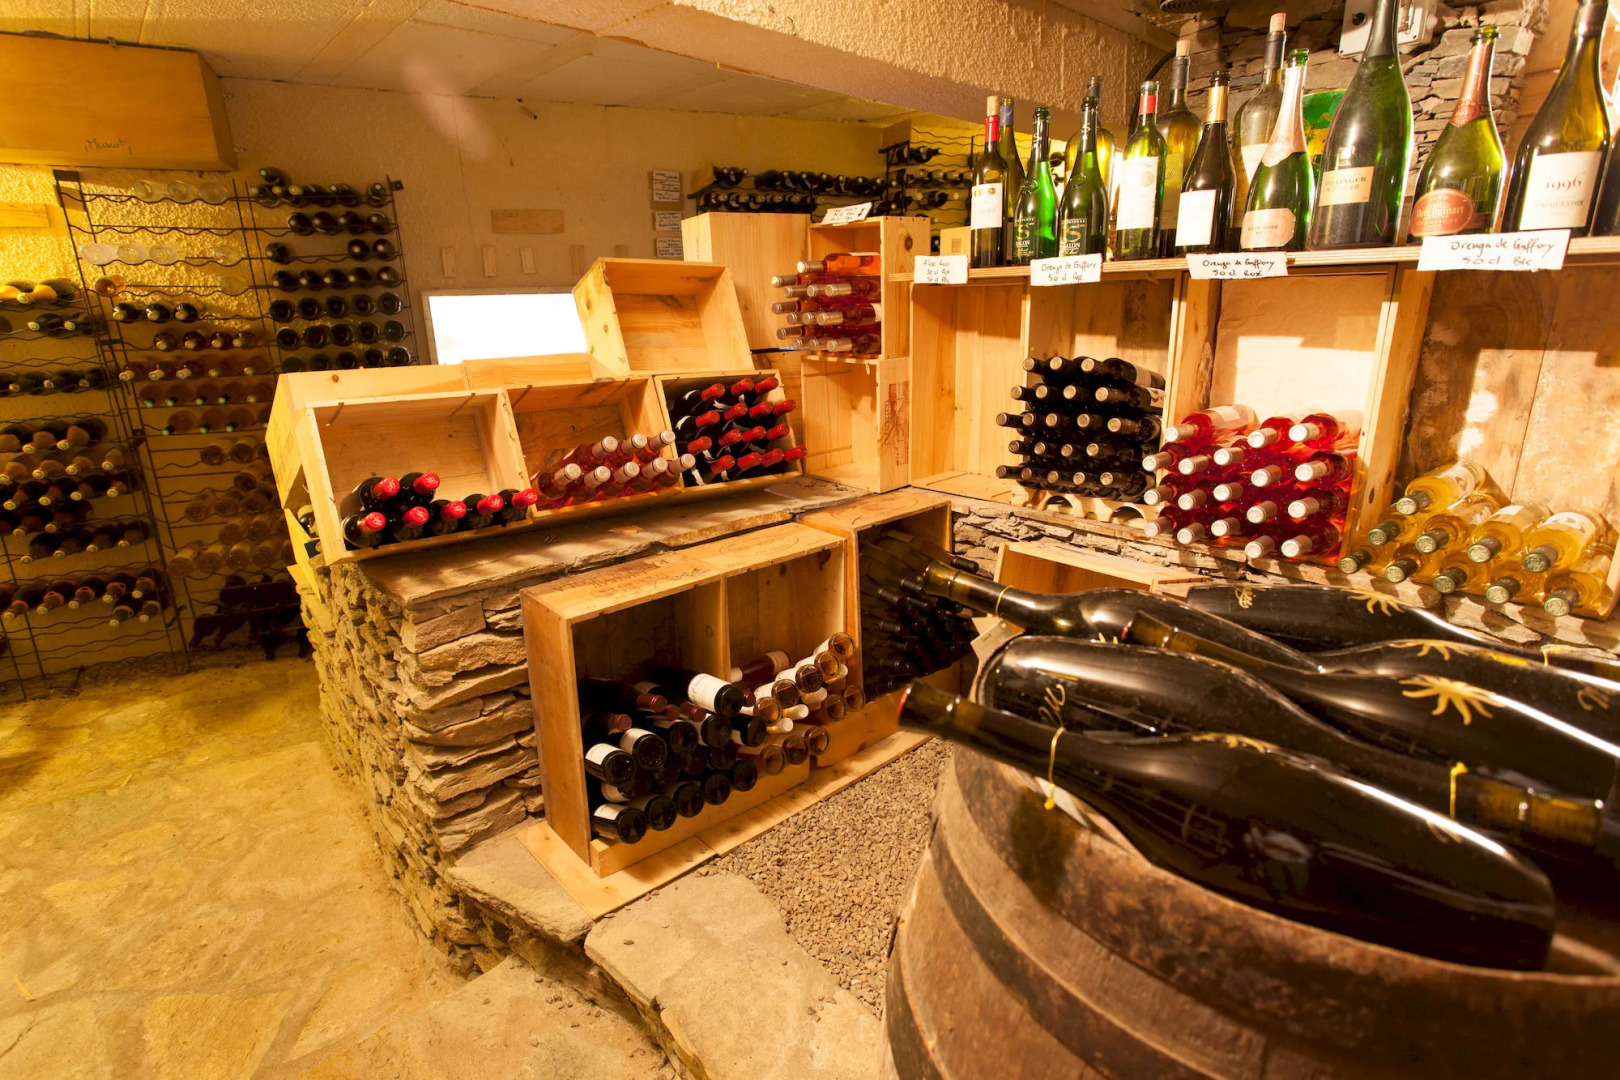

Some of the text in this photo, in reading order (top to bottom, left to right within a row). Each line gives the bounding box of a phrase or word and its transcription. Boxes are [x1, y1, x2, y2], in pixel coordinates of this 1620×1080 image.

[1546, 174, 1584, 192] 1996
[1495, 238, 1508, 249] de
[1461, 256, 1484, 265] 50
[1211, 269, 1226, 277] 50
